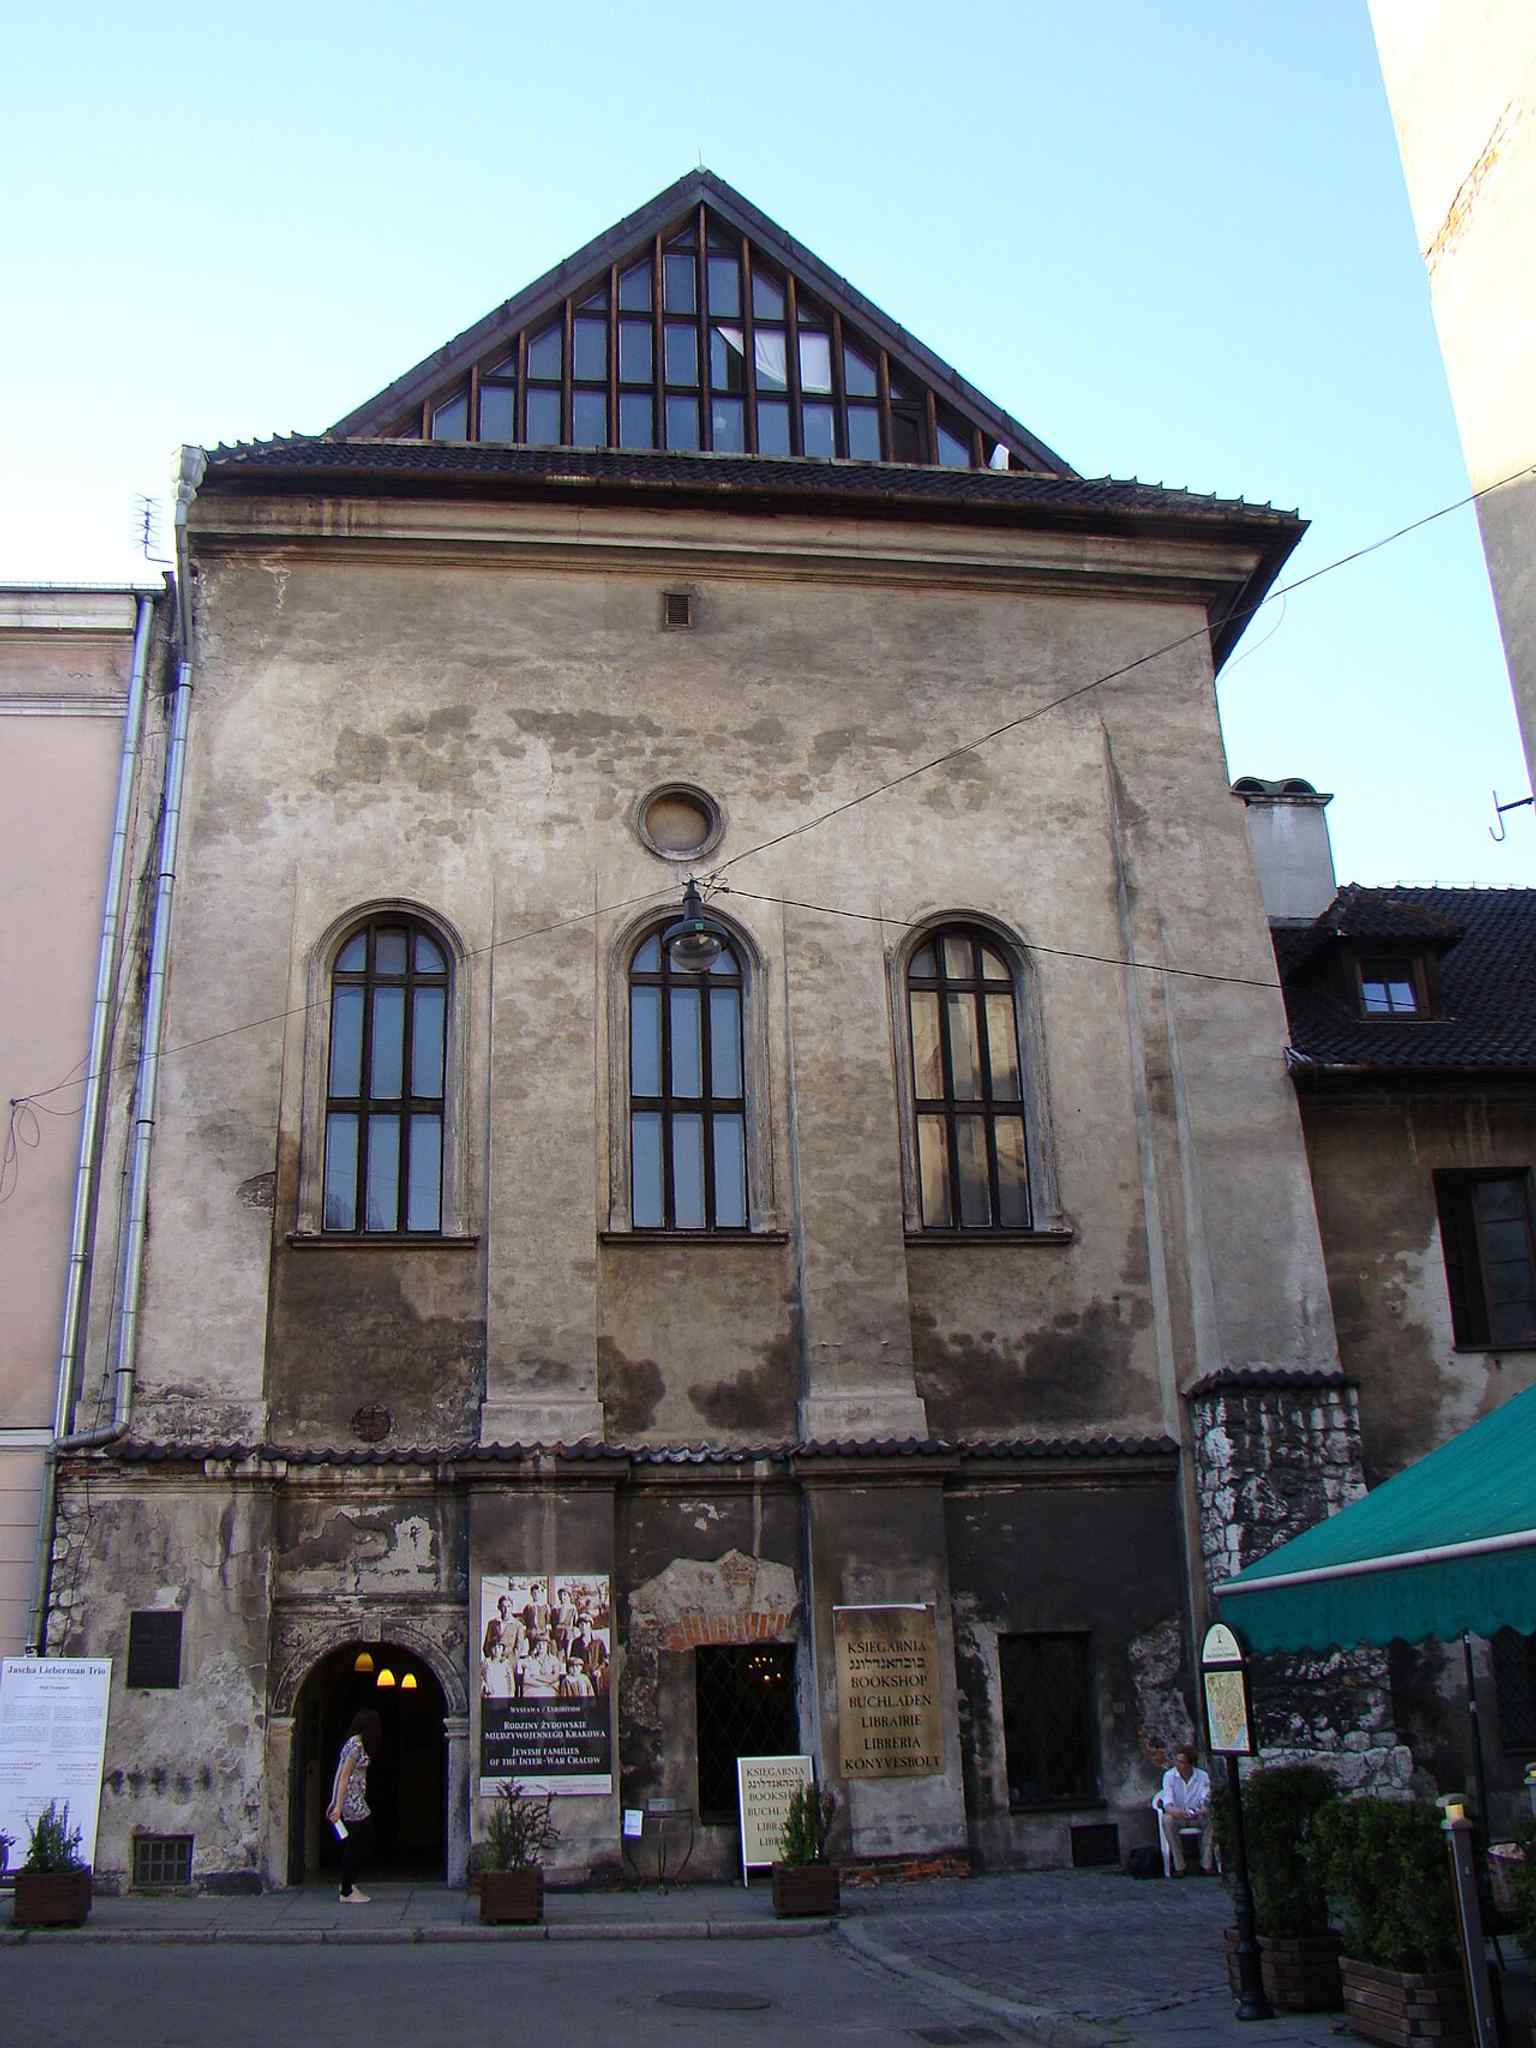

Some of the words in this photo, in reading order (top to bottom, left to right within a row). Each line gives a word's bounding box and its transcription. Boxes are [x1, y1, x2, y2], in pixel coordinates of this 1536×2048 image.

[7, 1665, 37, 1674] Jascha
[39, 1665, 86, 1674] Lieberman
[89, 1666, 106, 1675] Trio
[851, 1674, 928, 1689] BOOKSHOP
[849, 1694, 932, 1709] BUCHLADEN
[862, 1714, 921, 1728] LIBRAIRIE
[864, 1736, 921, 1750] LIBRERIA
